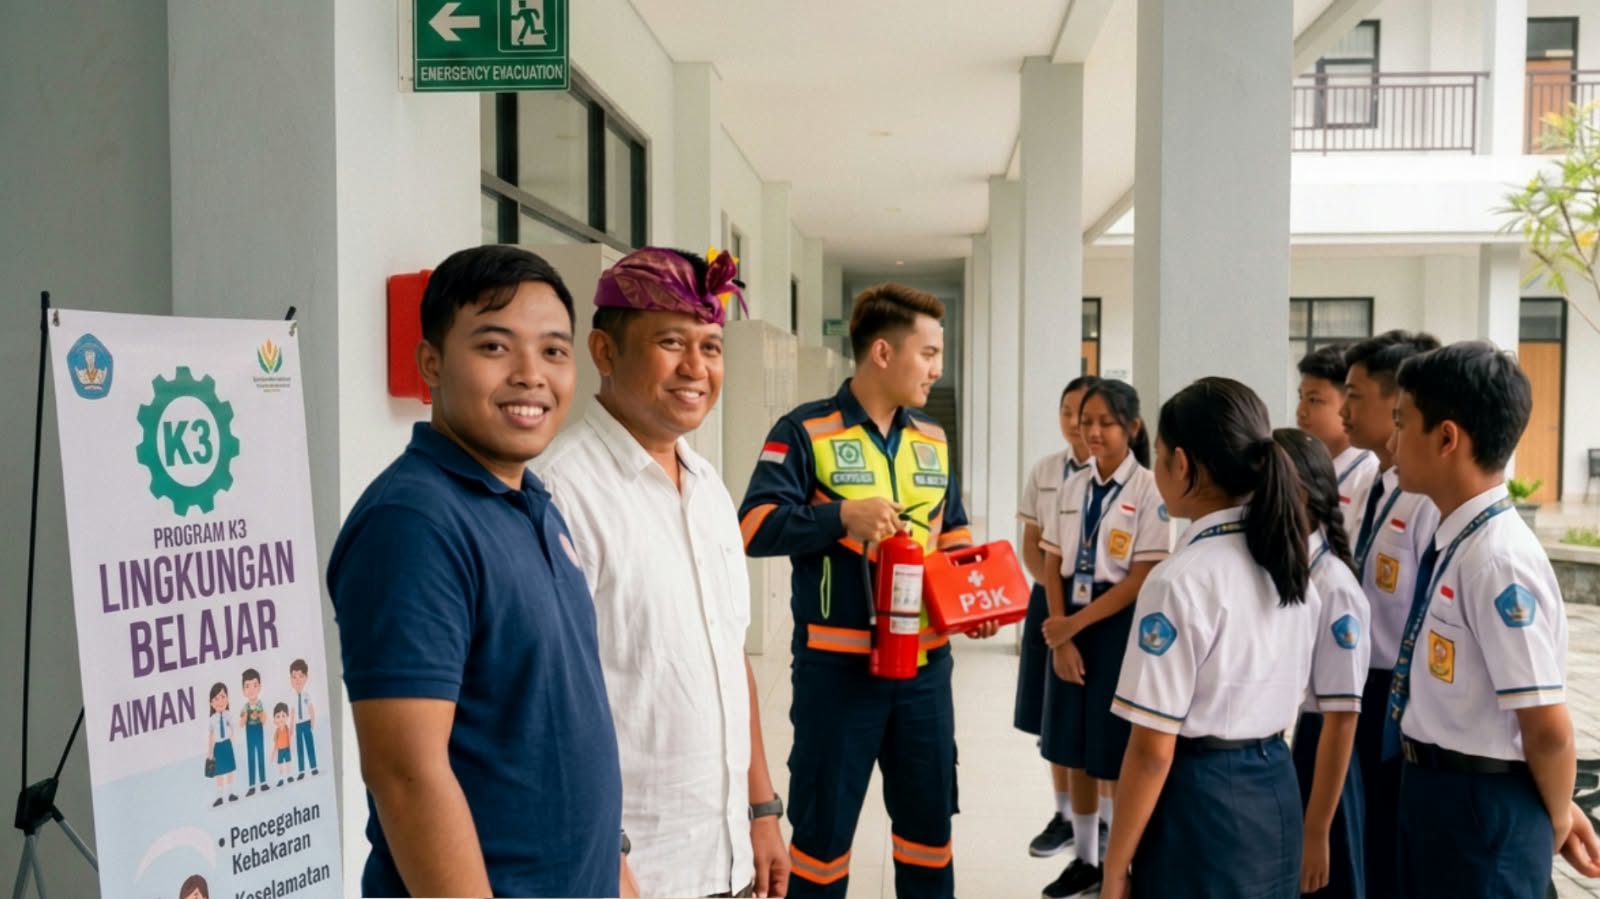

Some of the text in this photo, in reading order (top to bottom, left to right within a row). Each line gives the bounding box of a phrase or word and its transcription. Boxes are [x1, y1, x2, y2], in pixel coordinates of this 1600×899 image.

[164, 419, 213, 466] K3
[153, 518, 247, 549] PROGRAM K3
[99, 540, 295, 613] LINGKUNGAN
[960, 587, 1011, 613] P3K
[129, 599, 279, 678] BELAJAR
[109, 687, 196, 742] AIMAN
[230, 803, 320, 848] Pencegahan
[232, 833, 311, 875] Kebakaran
